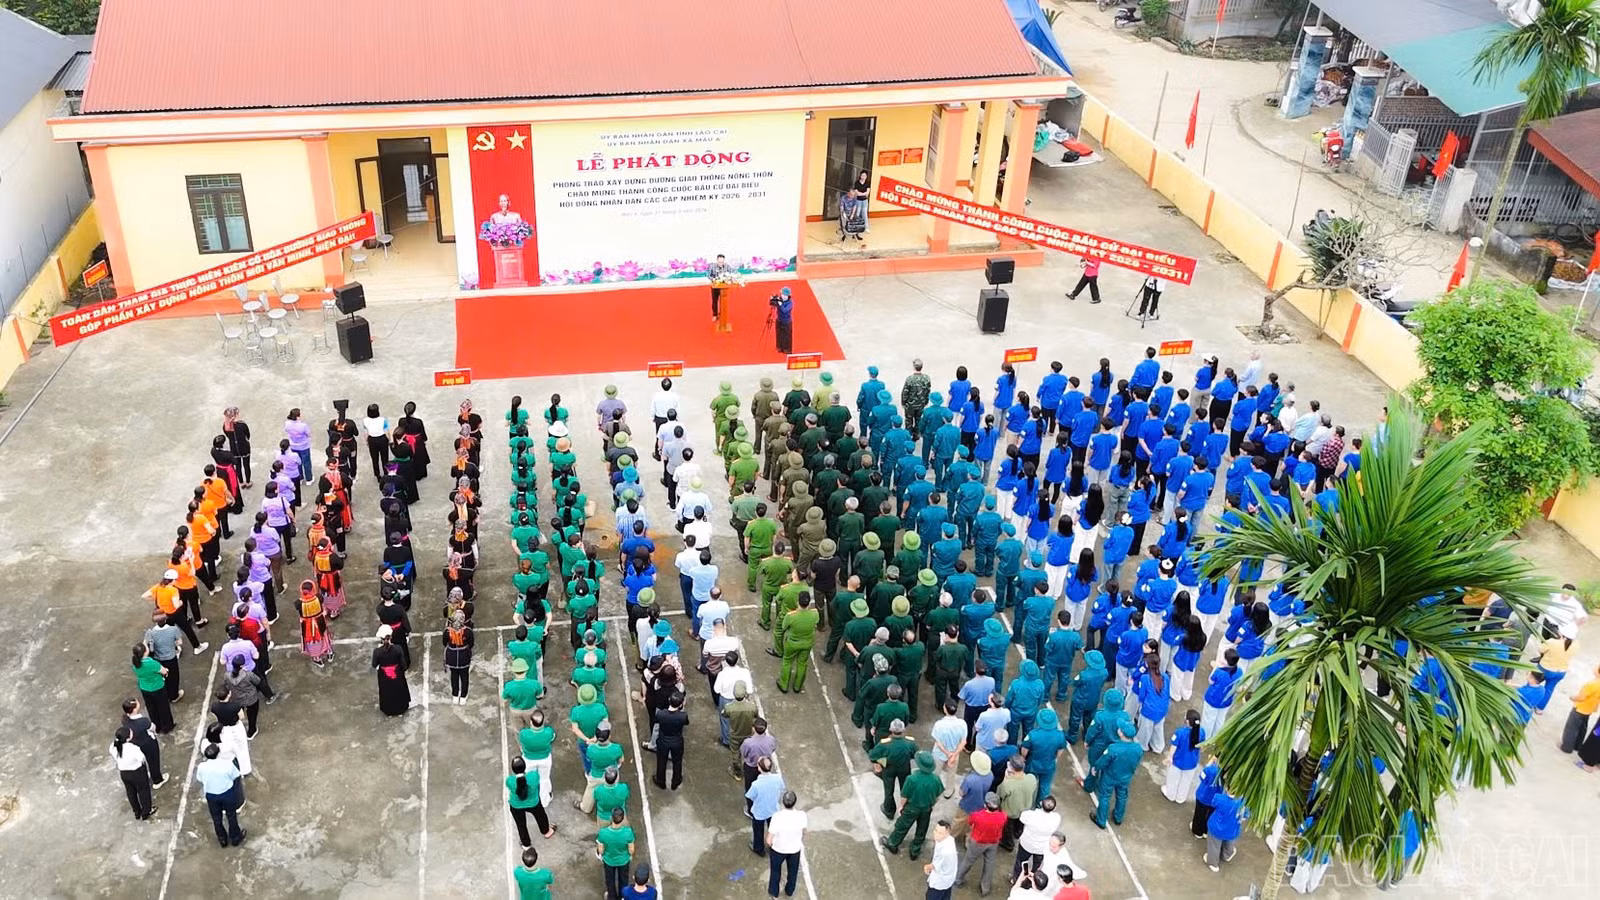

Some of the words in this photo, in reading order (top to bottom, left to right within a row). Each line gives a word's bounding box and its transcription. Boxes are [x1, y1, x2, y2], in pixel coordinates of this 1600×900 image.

[576, 152, 604, 171] LỄ
[612, 152, 676, 169] PHÁT
[553, 180, 581, 188] PHONG
[678, 175, 697, 183] GIAO
[721, 192, 740, 200] 2026
[895, 184, 924, 199] CHÀO
[1108, 253, 1140, 268] 2026
[118, 293, 149, 308] THAM
